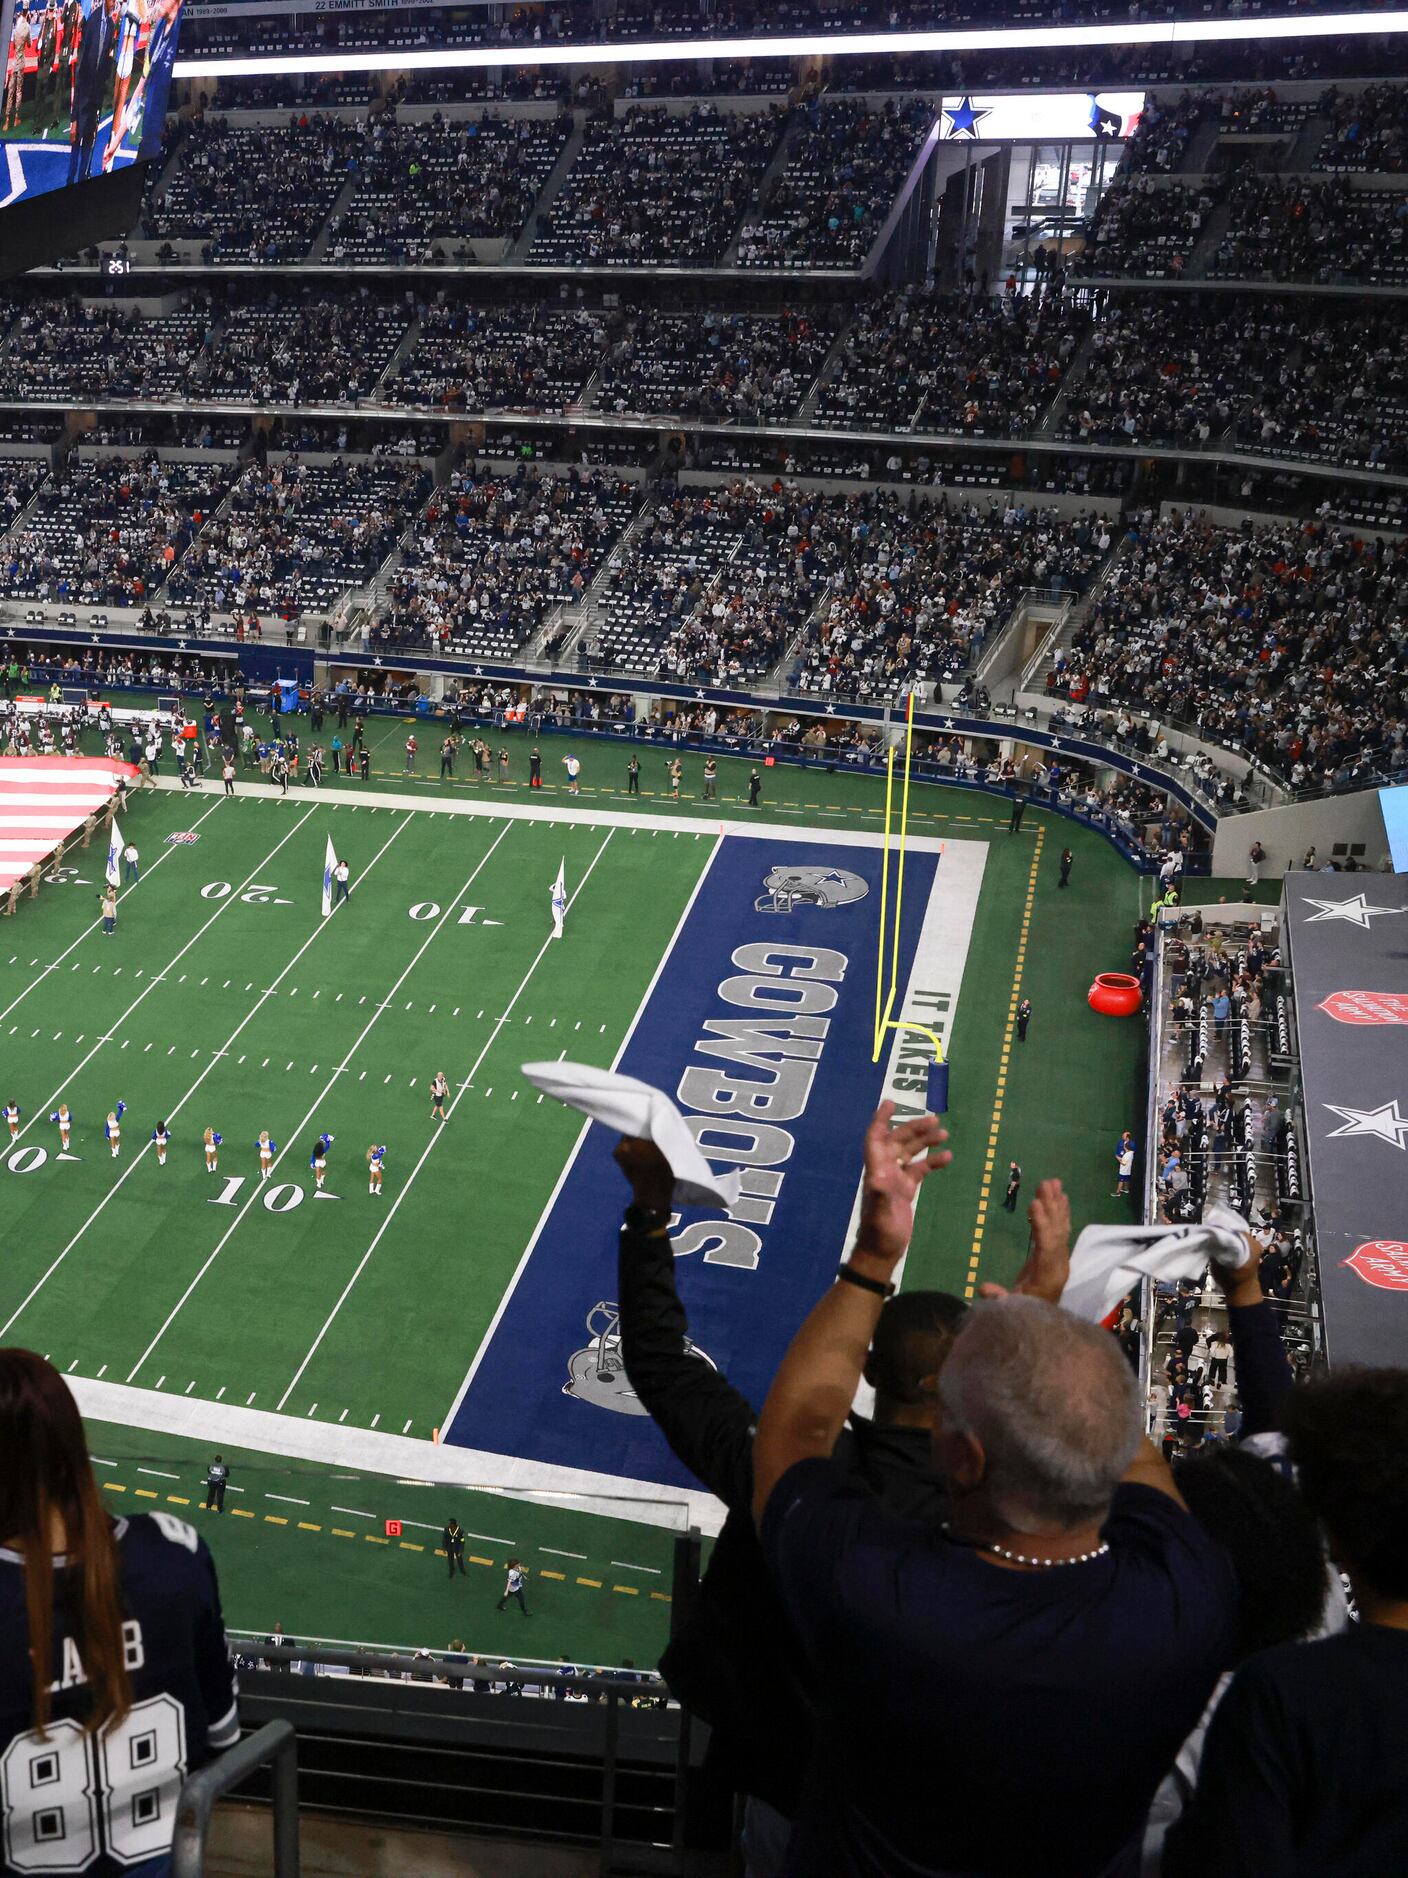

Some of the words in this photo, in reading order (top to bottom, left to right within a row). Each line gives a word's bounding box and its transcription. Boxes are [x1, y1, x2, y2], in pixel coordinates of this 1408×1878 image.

[315, 1, 326, 10] 22
[328, 0, 365, 9] EMMITT
[368, 0, 399, 8] SMITH
[200, 881, 280, 904] 20
[407, 902, 487, 925] 10
[911, 990, 952, 1013] IT
[206, 1175, 305, 1212] 10
[0, 1692, 188, 1875] 88
